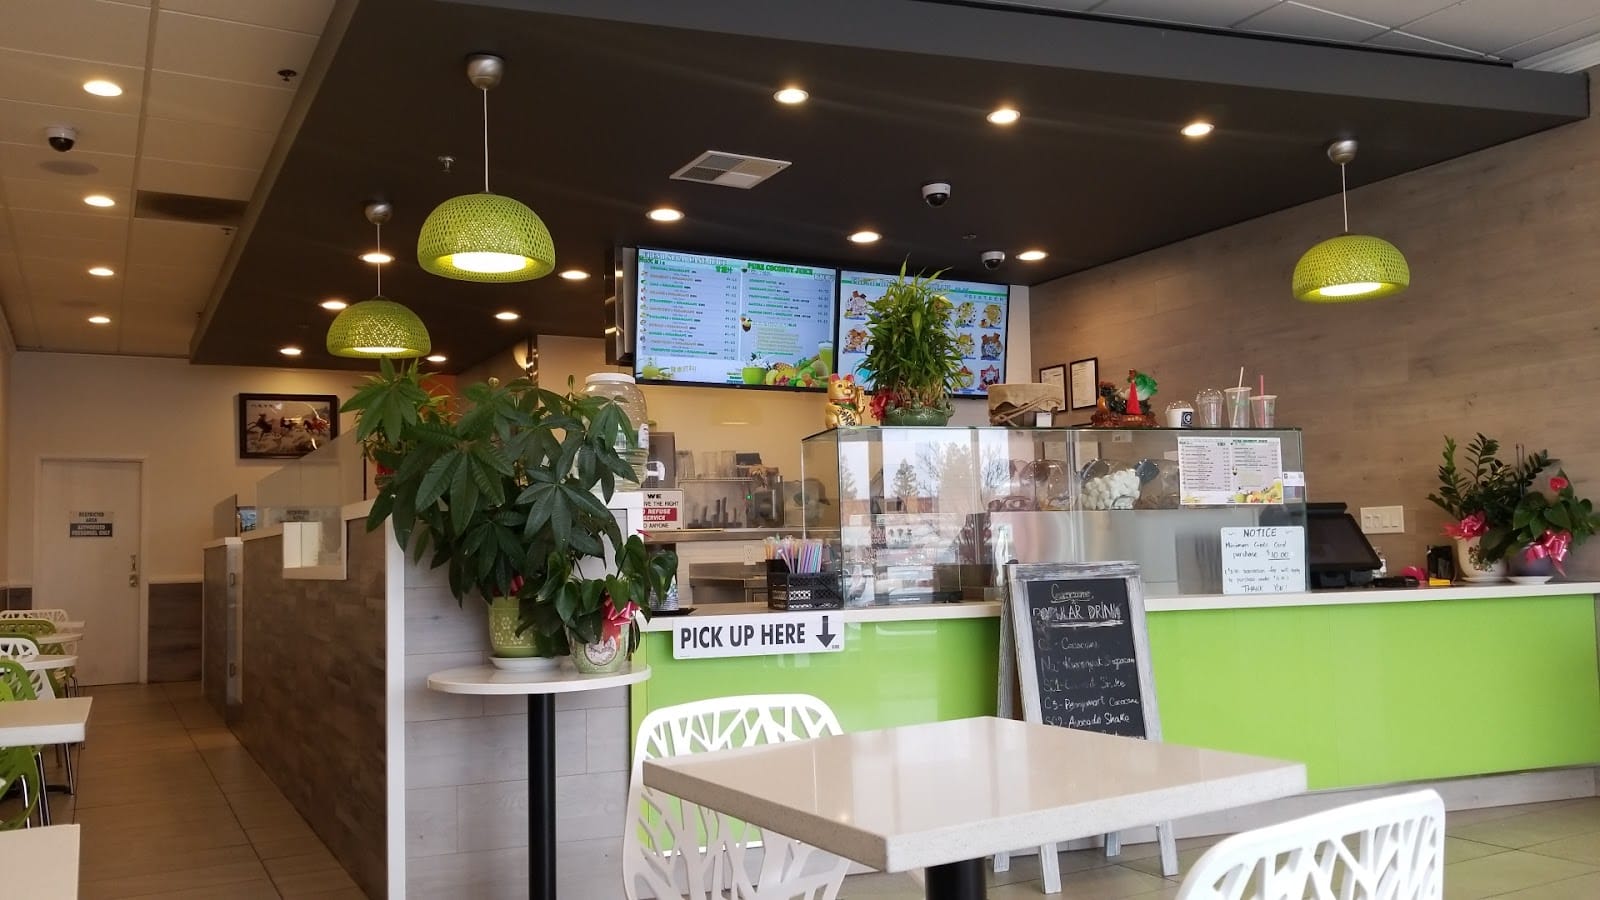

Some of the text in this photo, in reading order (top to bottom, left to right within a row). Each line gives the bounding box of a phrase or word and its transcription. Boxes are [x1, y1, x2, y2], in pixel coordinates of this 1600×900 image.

[1243, 528, 1277, 538] NOTICE
[680, 623, 806, 649] PICK UP HERE
[1104, 712, 1130, 726] Shake
